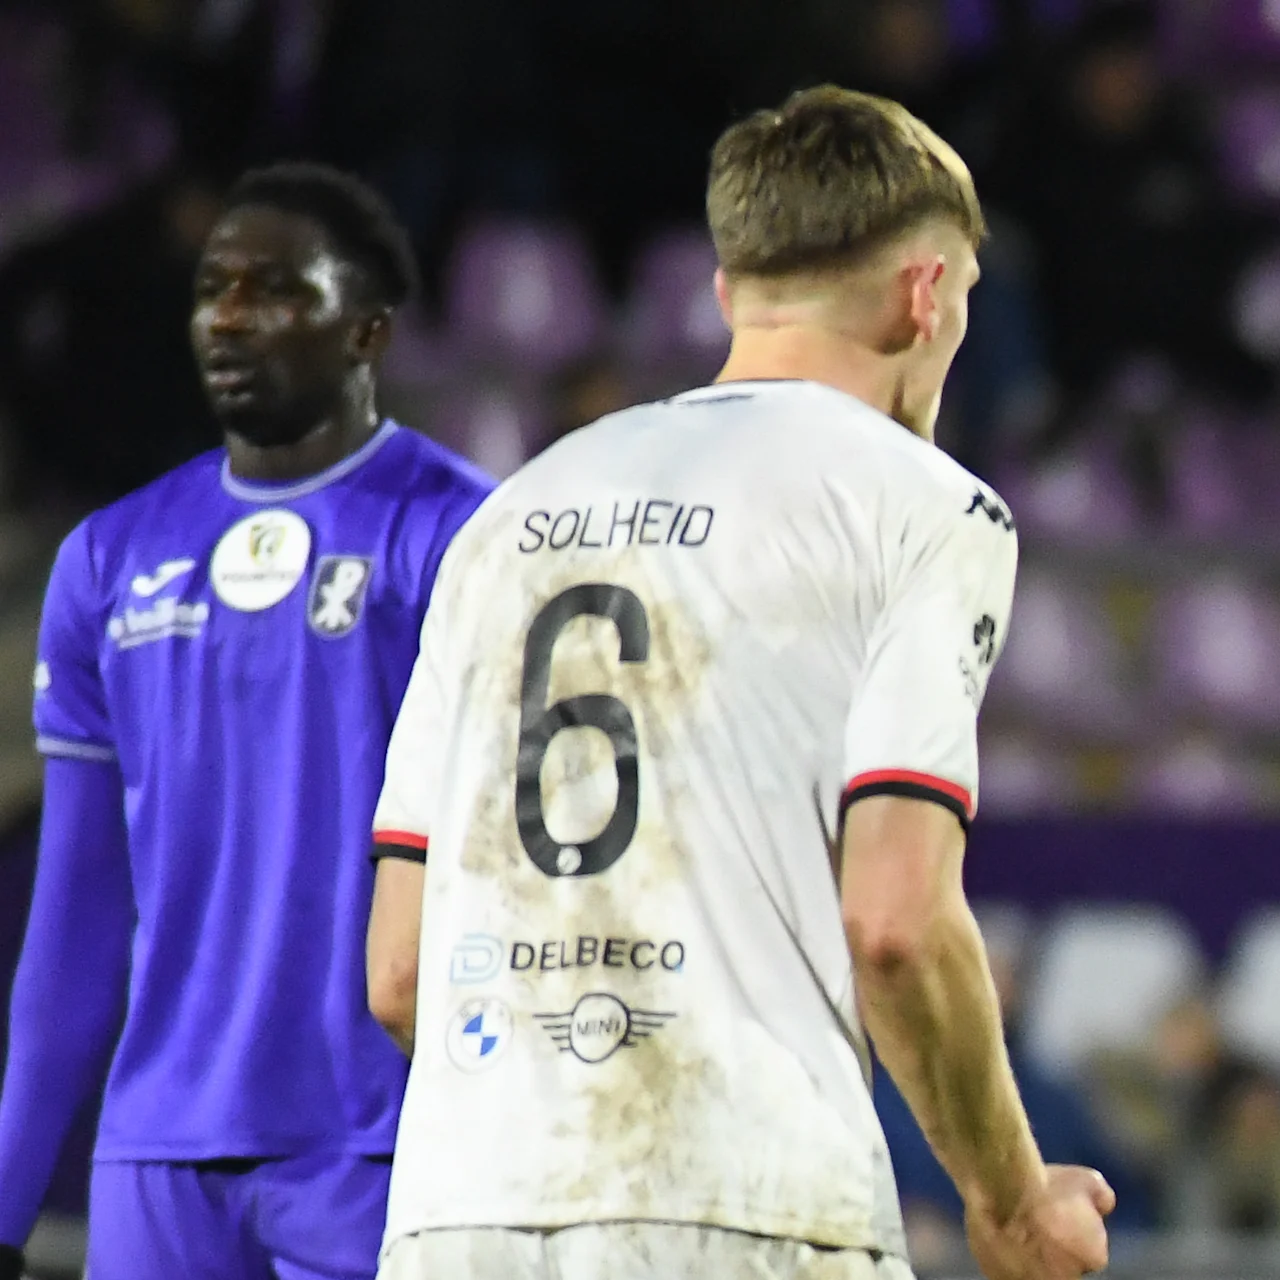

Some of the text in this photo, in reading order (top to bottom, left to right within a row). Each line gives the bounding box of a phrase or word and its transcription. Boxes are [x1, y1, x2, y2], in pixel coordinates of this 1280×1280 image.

[517, 501, 715, 553] SOLHEID
[515, 582, 650, 879] 6
[510, 936, 686, 972] DELBECO
